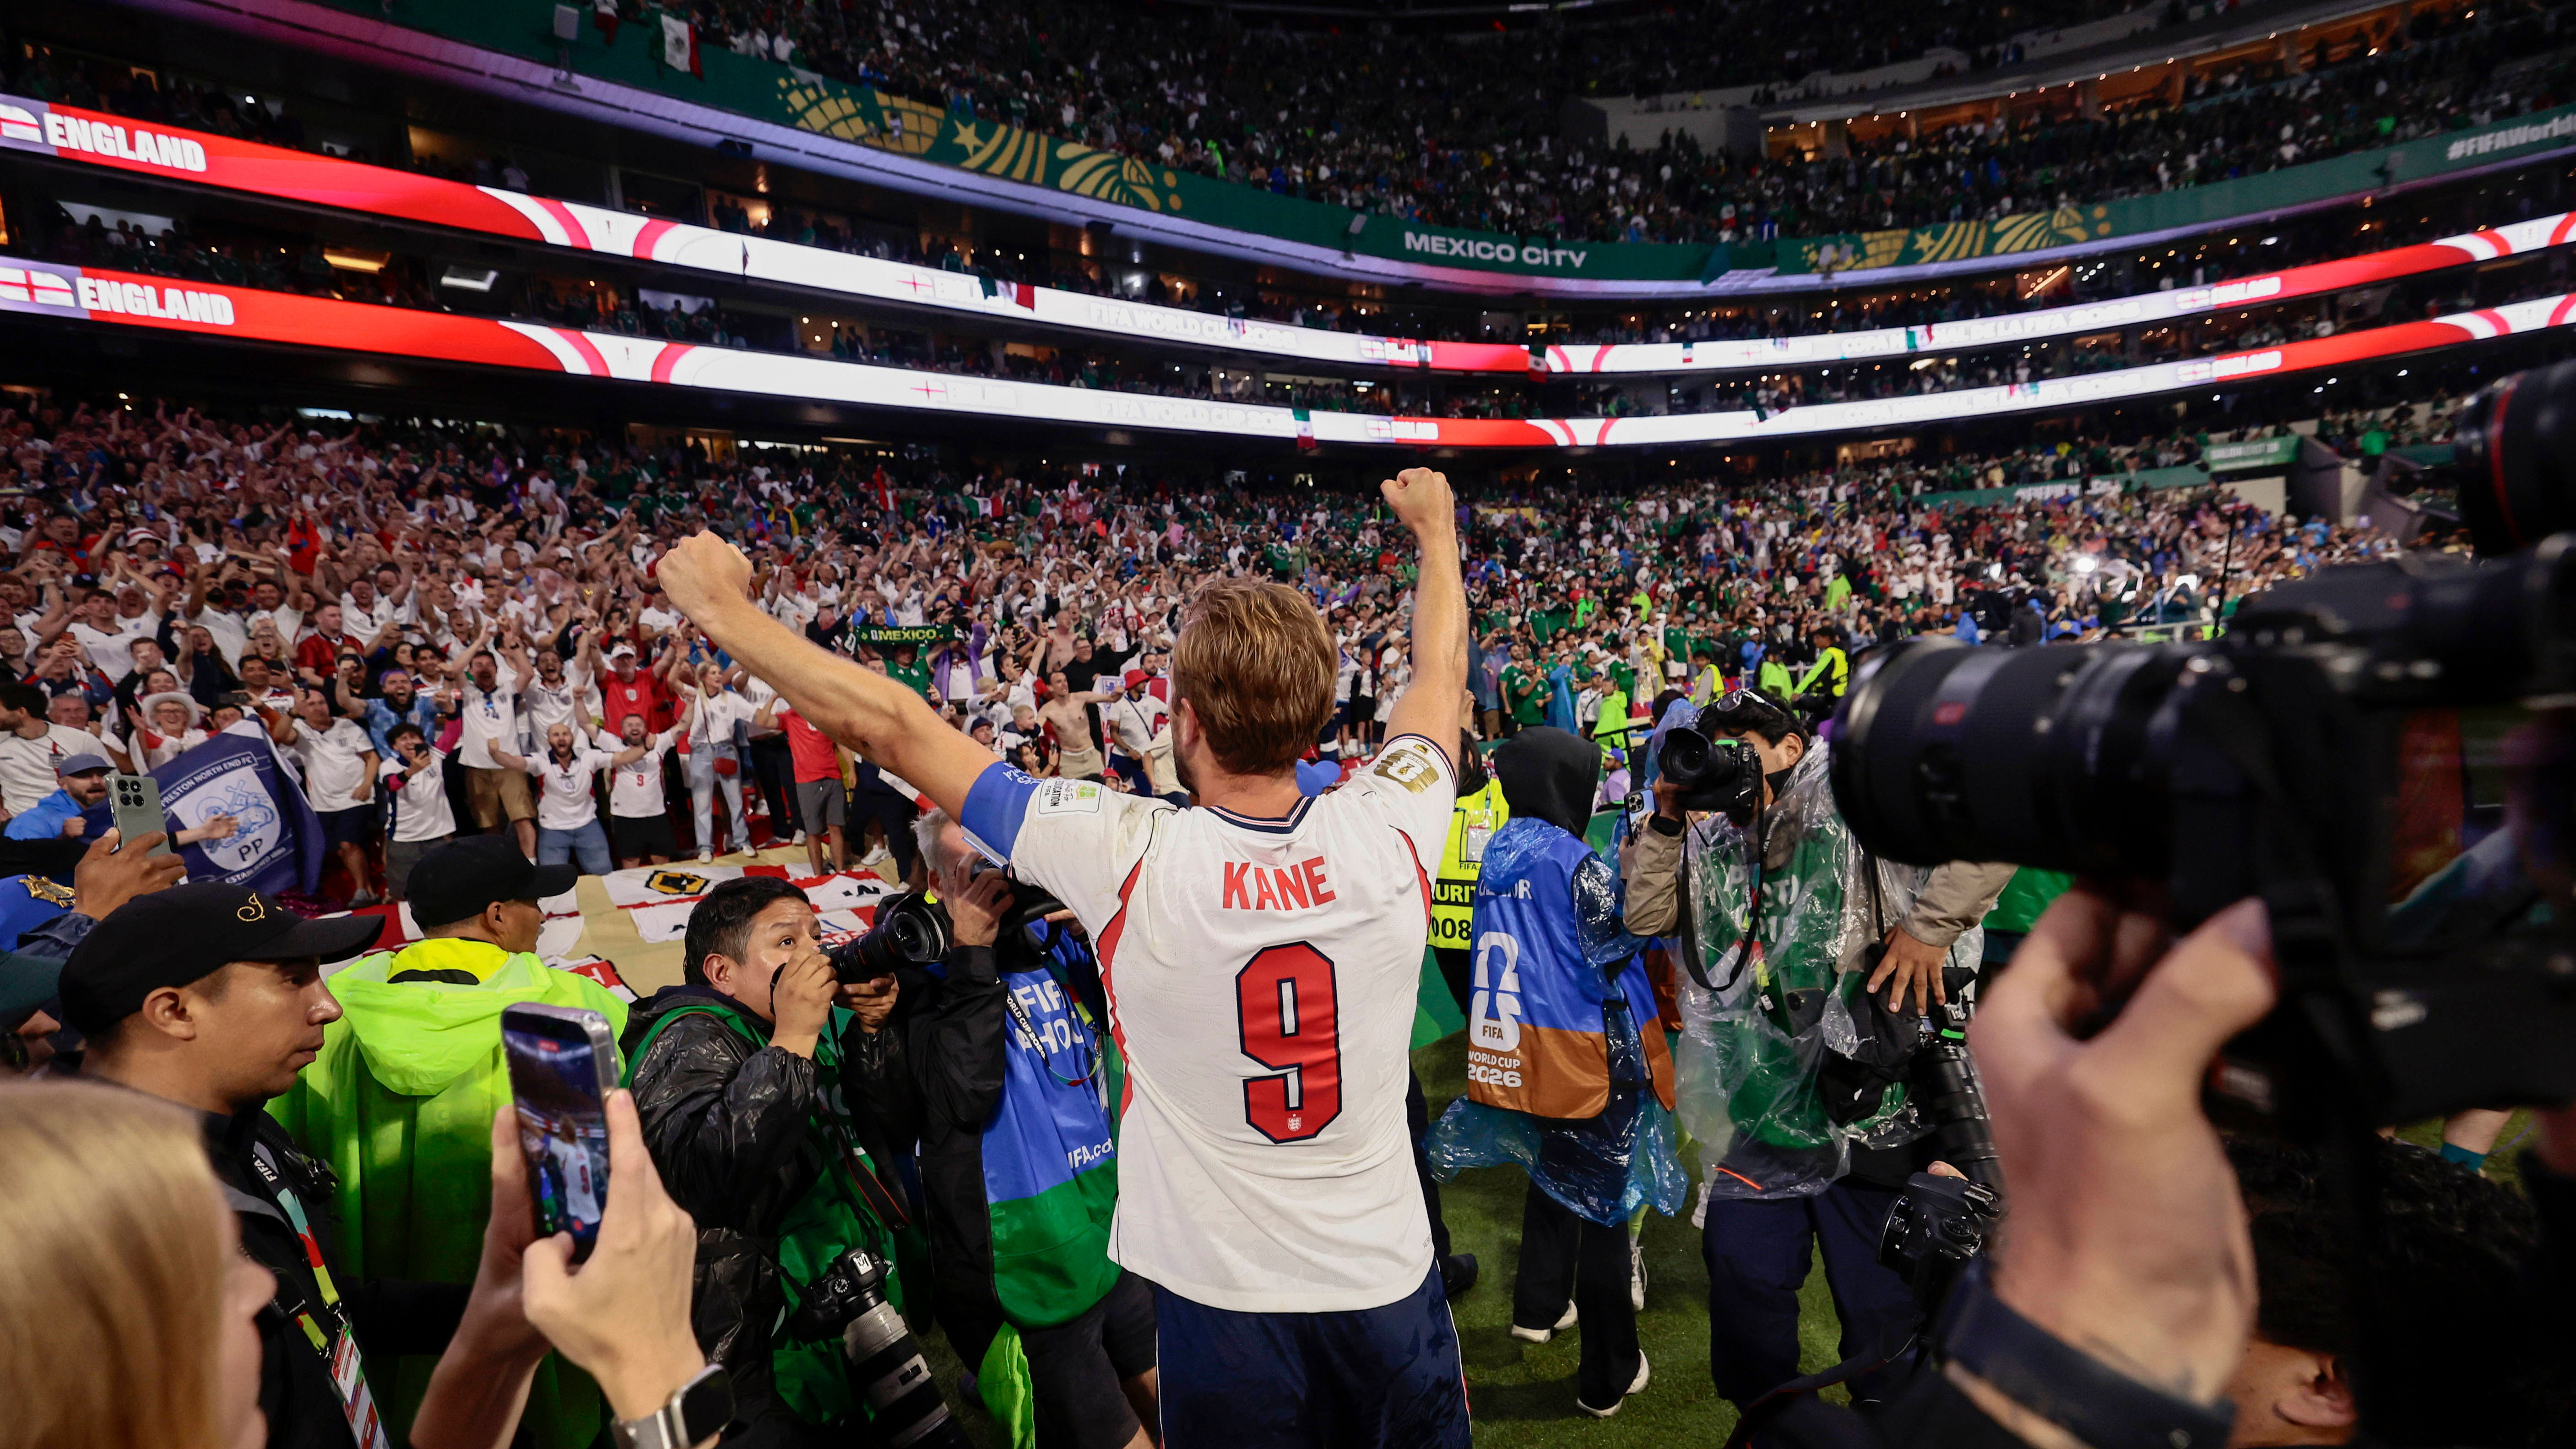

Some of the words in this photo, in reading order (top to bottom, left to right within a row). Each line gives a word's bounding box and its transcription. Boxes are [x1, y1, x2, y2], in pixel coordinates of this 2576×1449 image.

[43, 112, 206, 172] ENGLAND
[1405, 231, 1516, 262] MEXICO
[1522, 246, 1587, 268] CITY
[76, 277, 234, 325] ENGLAND
[1090, 303, 1132, 327] FIFA
[1133, 309, 1200, 336] WORLD
[1099, 397, 1143, 420] FIFA
[1143, 400, 1209, 425] WORLD
[1211, 407, 1246, 427] CUP
[877, 629, 937, 641] MEXICO
[161, 780, 195, 807] PRESTON
[196, 764, 223, 784] NORTH
[224, 758, 241, 771] END
[241, 756, 253, 765] FC
[637, 775, 644, 787] 9
[1050, 781, 1064, 807] EDUCATION
[1223, 856, 1336, 911] KANE
[1019, 1017, 1032, 1034] CUP
[1028, 1032, 1046, 1060] 2026
[1235, 940, 1342, 1145] 9
[1482, 1025, 1504, 1041] FIFA
[1468, 1050, 1497, 1066] WORLD
[1498, 1056, 1521, 1069] CUP
[1467, 1063, 1522, 1088] 2026
[254, 1159, 278, 1182] FIFA
